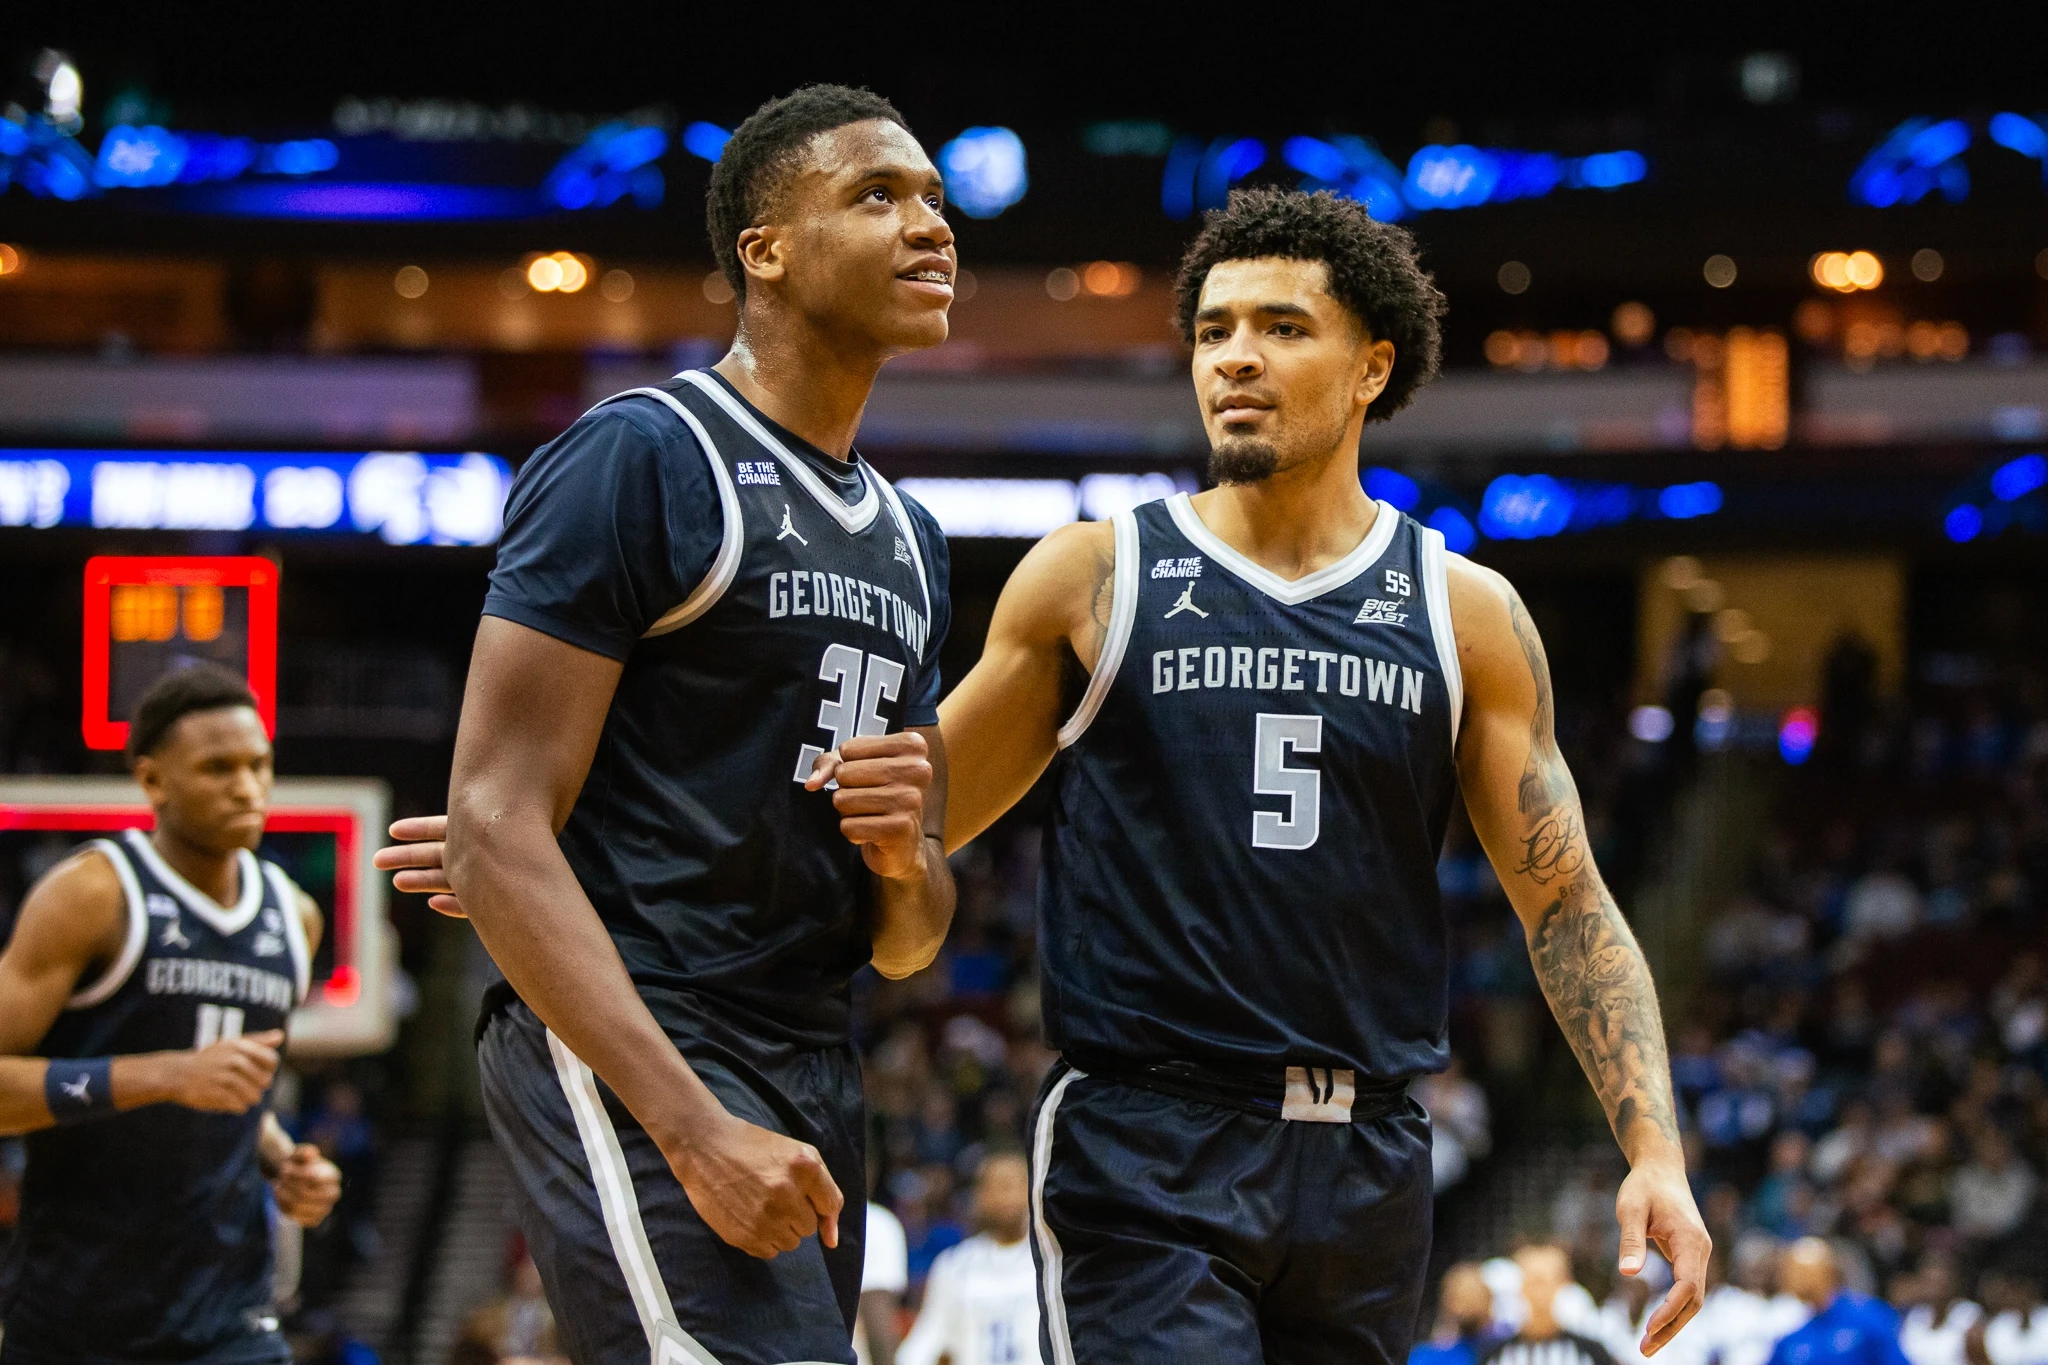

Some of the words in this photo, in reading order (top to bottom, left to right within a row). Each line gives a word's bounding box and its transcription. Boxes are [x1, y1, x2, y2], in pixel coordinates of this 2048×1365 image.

[738, 462, 754, 473] BE
[755, 462, 776, 473] THE
[738, 473, 781, 486] CHANGE
[1157, 559, 1175, 568] BE
[1178, 556, 1201, 567] THE
[1151, 566, 1203, 579] CHANGE
[1362, 598, 1399, 611] BIG
[769, 570, 926, 665] GEORGETOWN
[1356, 610, 1409, 623] EAST
[1152, 646, 1424, 715] GEORGETOWN
[1252, 712, 1323, 851] 5
[146, 957, 292, 1012] GEORGETOWN
